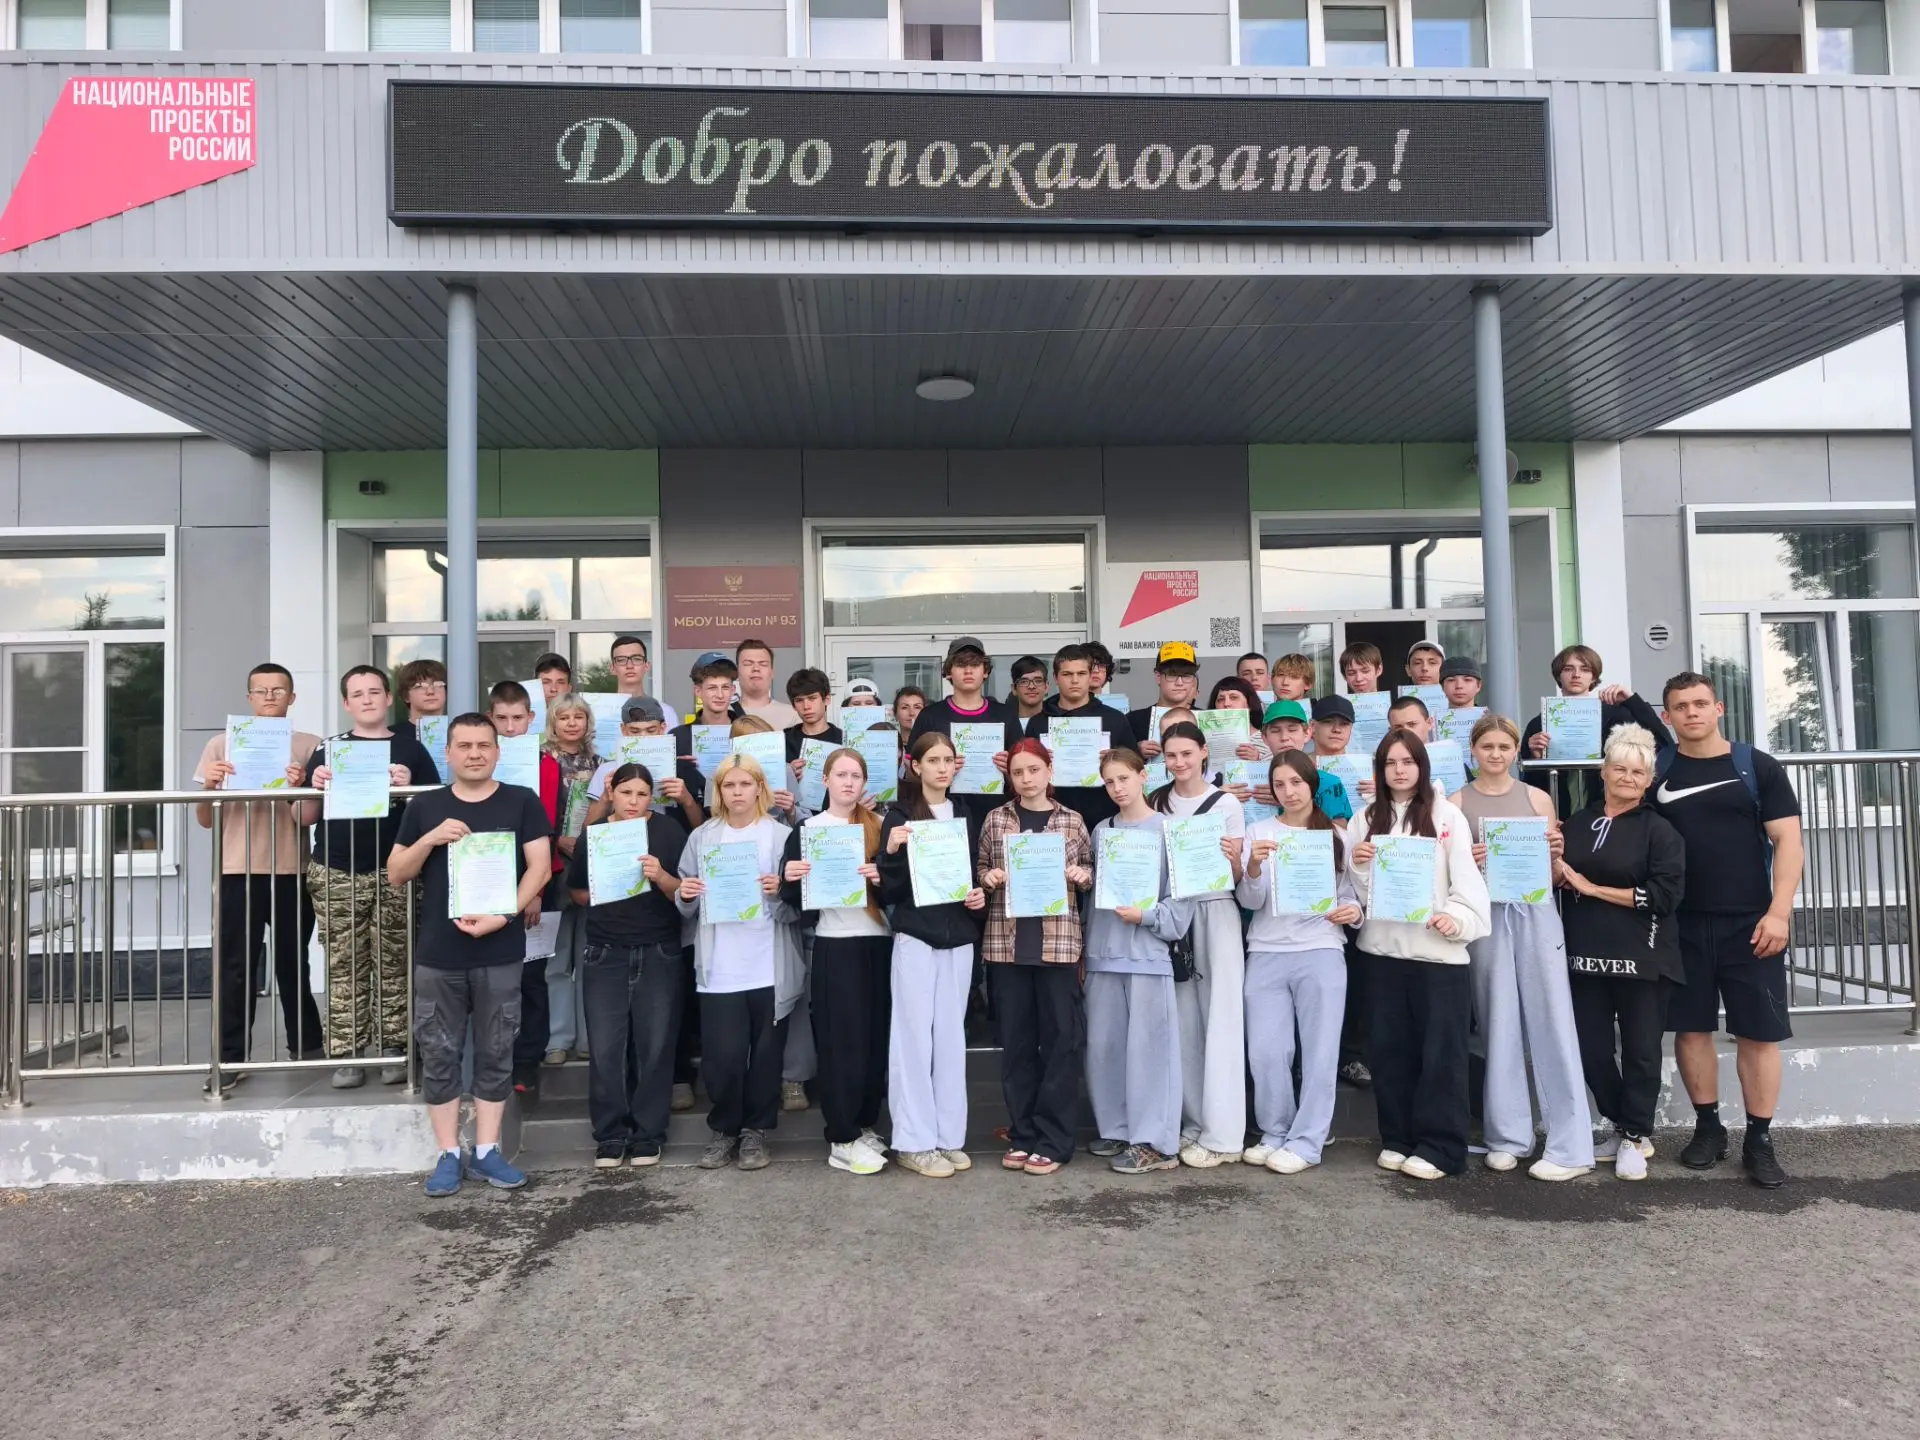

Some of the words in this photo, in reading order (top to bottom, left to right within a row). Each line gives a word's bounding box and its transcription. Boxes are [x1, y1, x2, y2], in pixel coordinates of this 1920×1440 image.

[72, 80, 251, 108] НАЦИОНАЛЬНЫЕ
[150, 109, 251, 133] ПРОЕКТЫ
[168, 136, 251, 161] РОССИИ
[556, 106, 832, 214] Добро
[862, 128, 1411, 209] пожаловать!
[1143, 571, 1197, 580] НАЦИОНАЛЬНЫЕ
[1166, 580, 1197, 589] ПРОЕКТЫ
[1172, 588, 1197, 597] РОССИИ
[674, 616, 713, 627] МБОУ
[715, 615, 762, 627] Школа
[780, 615, 797, 626] 93
[1119, 641, 1133, 650] НАМ
[1134, 641, 1156, 650] ВАЖНО
[1567, 955, 1638, 974] OREVER
